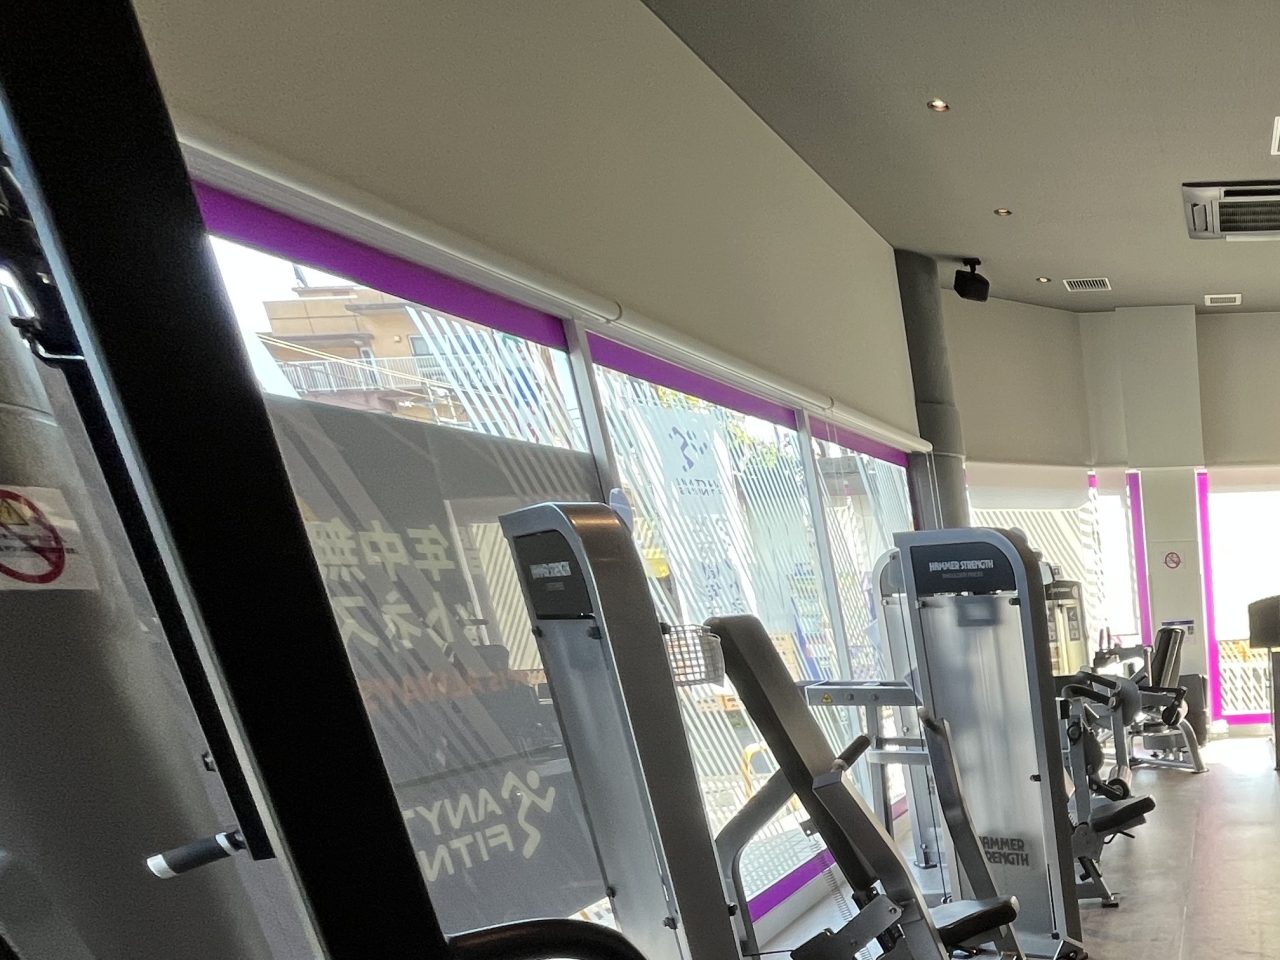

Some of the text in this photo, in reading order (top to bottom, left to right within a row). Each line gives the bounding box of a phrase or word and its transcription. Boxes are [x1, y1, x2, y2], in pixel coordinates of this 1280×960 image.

[929, 559, 993, 572] HAMMER STRENGTH
[979, 836, 1025, 851] AMMER
[985, 851, 1030, 866] RENGTH
